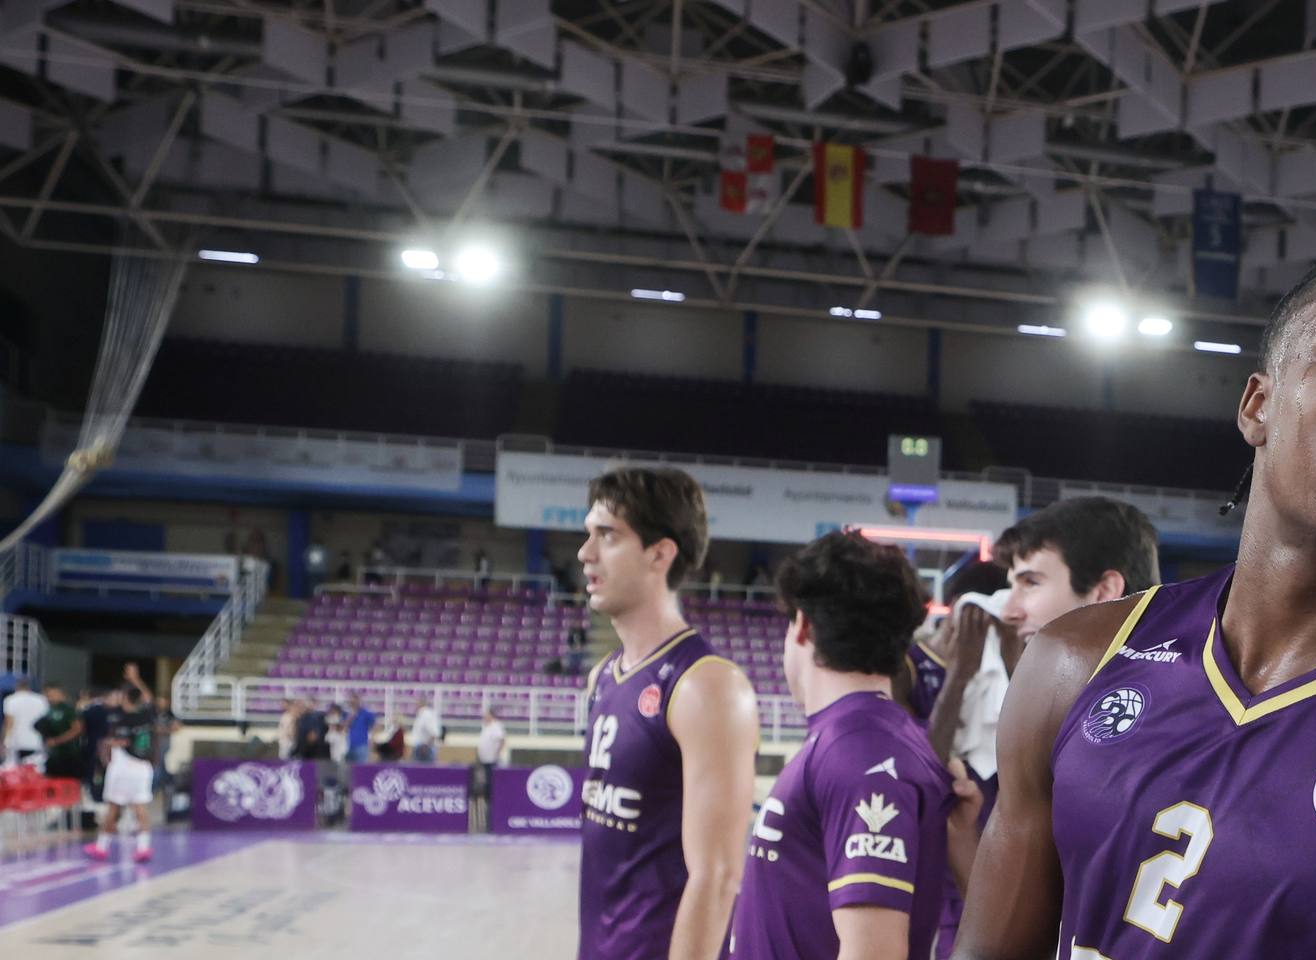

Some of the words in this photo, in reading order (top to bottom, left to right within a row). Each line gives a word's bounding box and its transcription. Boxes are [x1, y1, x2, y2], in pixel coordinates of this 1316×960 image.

[1118, 645, 1182, 663] MERCURY
[589, 714, 619, 770] 12
[397, 797, 467, 814] ACEVES
[844, 832, 908, 864] CRZA
[1123, 800, 1214, 944] 2
